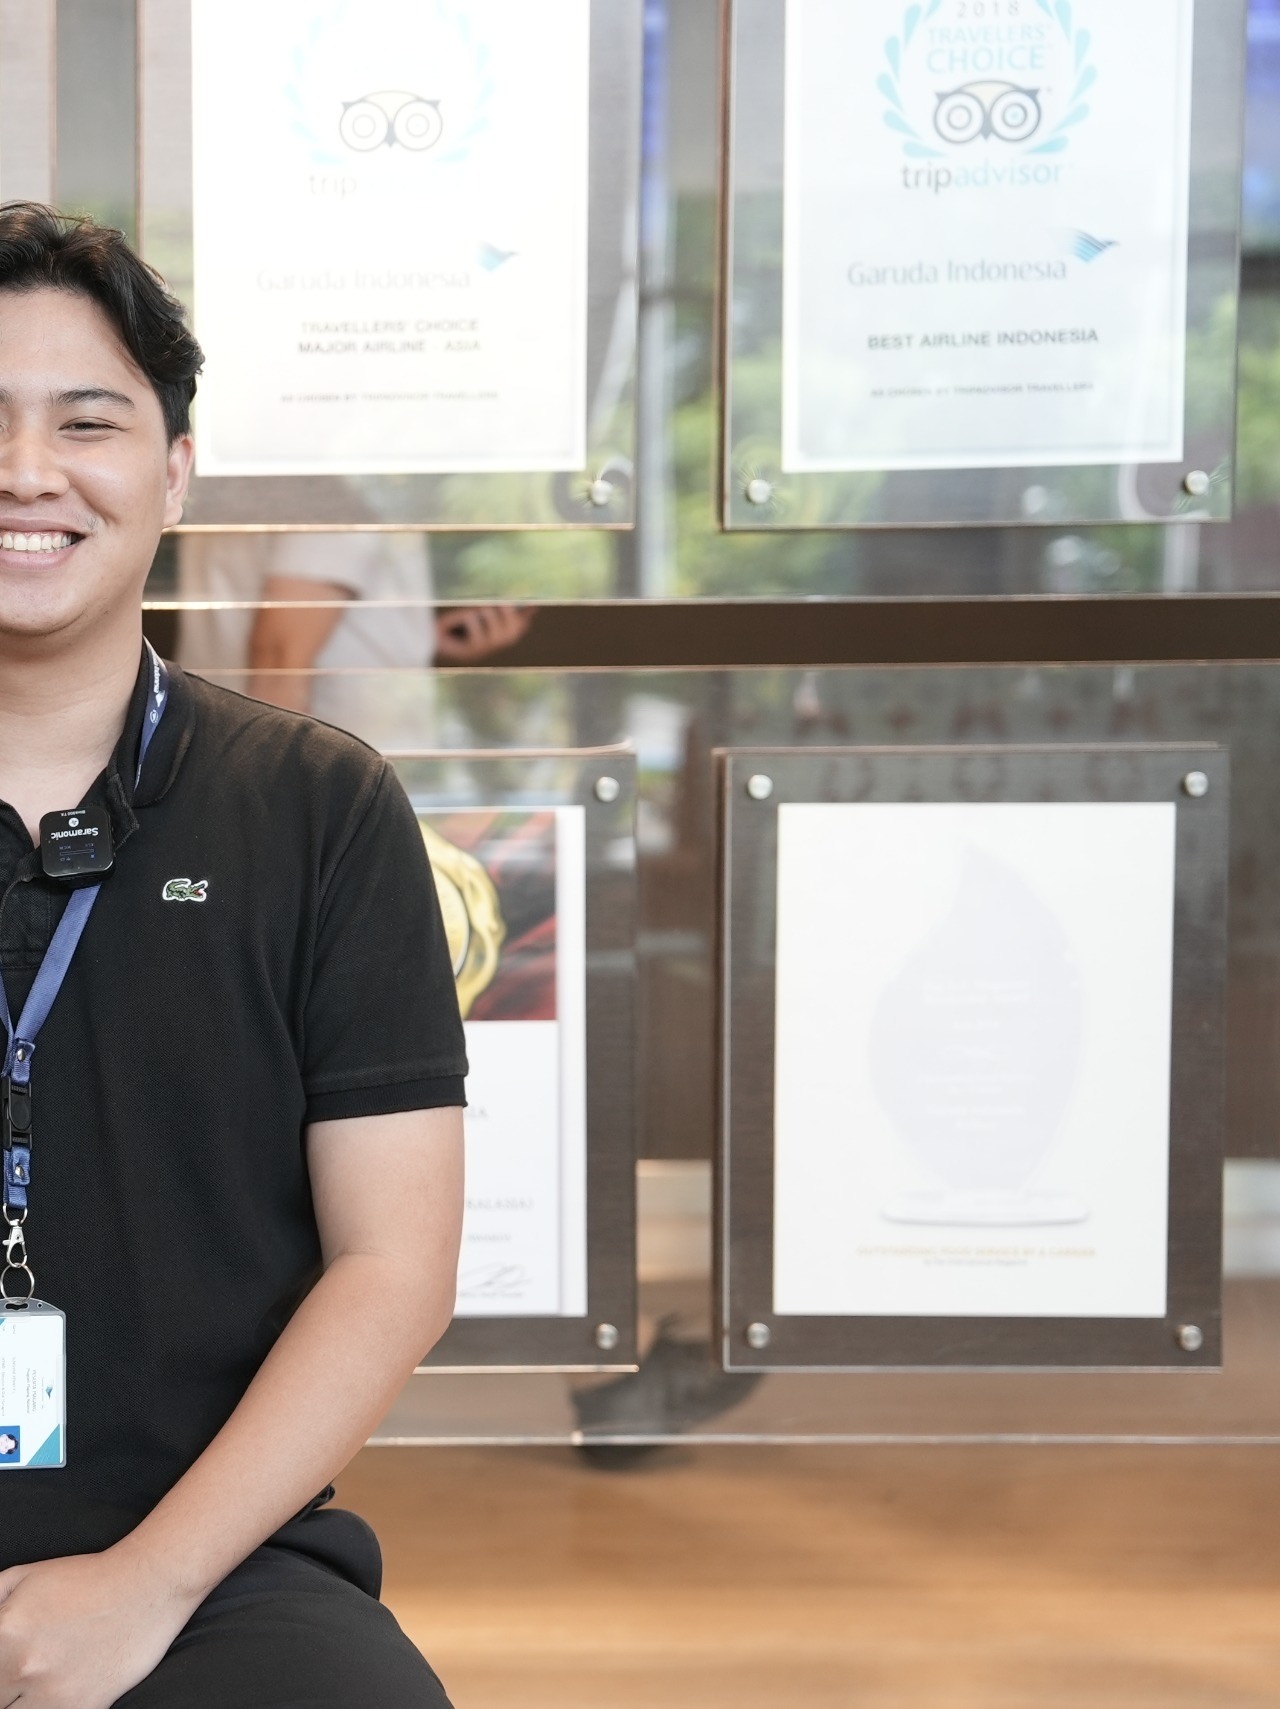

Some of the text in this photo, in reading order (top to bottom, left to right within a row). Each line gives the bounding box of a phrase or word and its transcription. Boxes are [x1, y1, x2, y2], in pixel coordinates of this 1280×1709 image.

[956, 0, 1021, 18] 2018
[925, 44, 1046, 75] CHOICE
[901, 157, 1063, 195] tripadvisor
[255, 268, 472, 292] Garuda Indonesia
[846, 257, 1067, 288] Garuda Indonesia
[414, 317, 480, 333] CHOICE
[297, 340, 357, 355] MAJOR
[362, 339, 427, 354] AIRLINE
[443, 339, 482, 353] ASIA
[867, 328, 1100, 350] BEST AIRLINE INDONESIA
[50, 827, 99, 841] Saramonic
